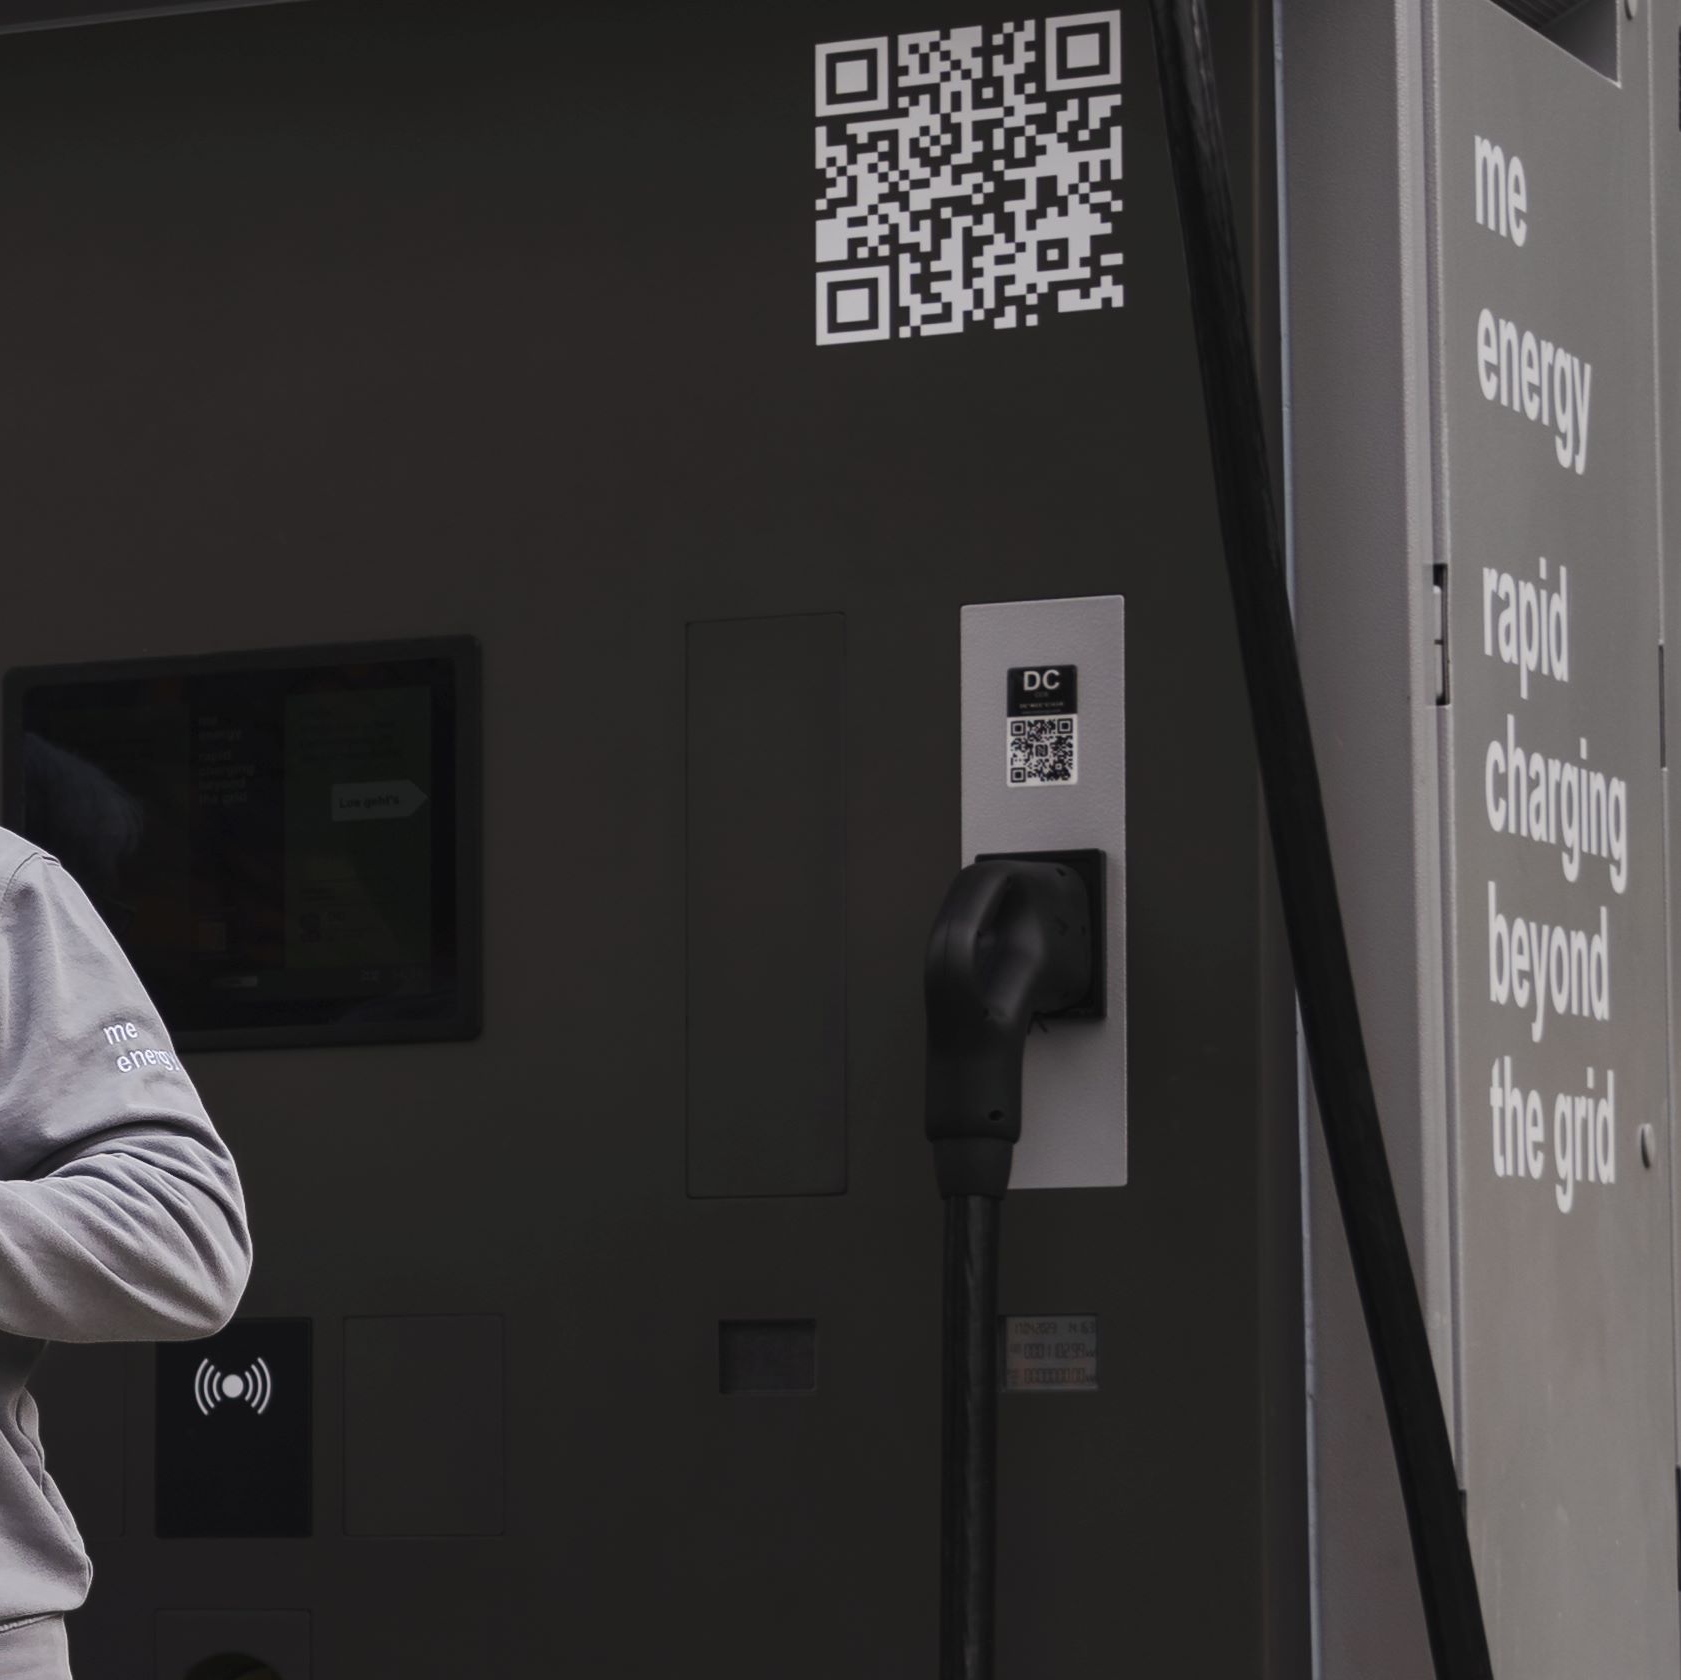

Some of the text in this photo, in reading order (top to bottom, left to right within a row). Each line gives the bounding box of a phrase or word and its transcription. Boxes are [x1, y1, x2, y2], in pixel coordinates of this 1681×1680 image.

[1474, 135, 1528, 247] me
[1477, 308, 1592, 475] energy
[1023, 669, 1061, 692] DC
[1482, 556, 1569, 700] rapid
[1485, 714, 1628, 895] charging
[102, 1022, 139, 1046] me
[1487, 879, 1610, 1042] beyond
[1489, 1055, 1616, 1214] the grid
